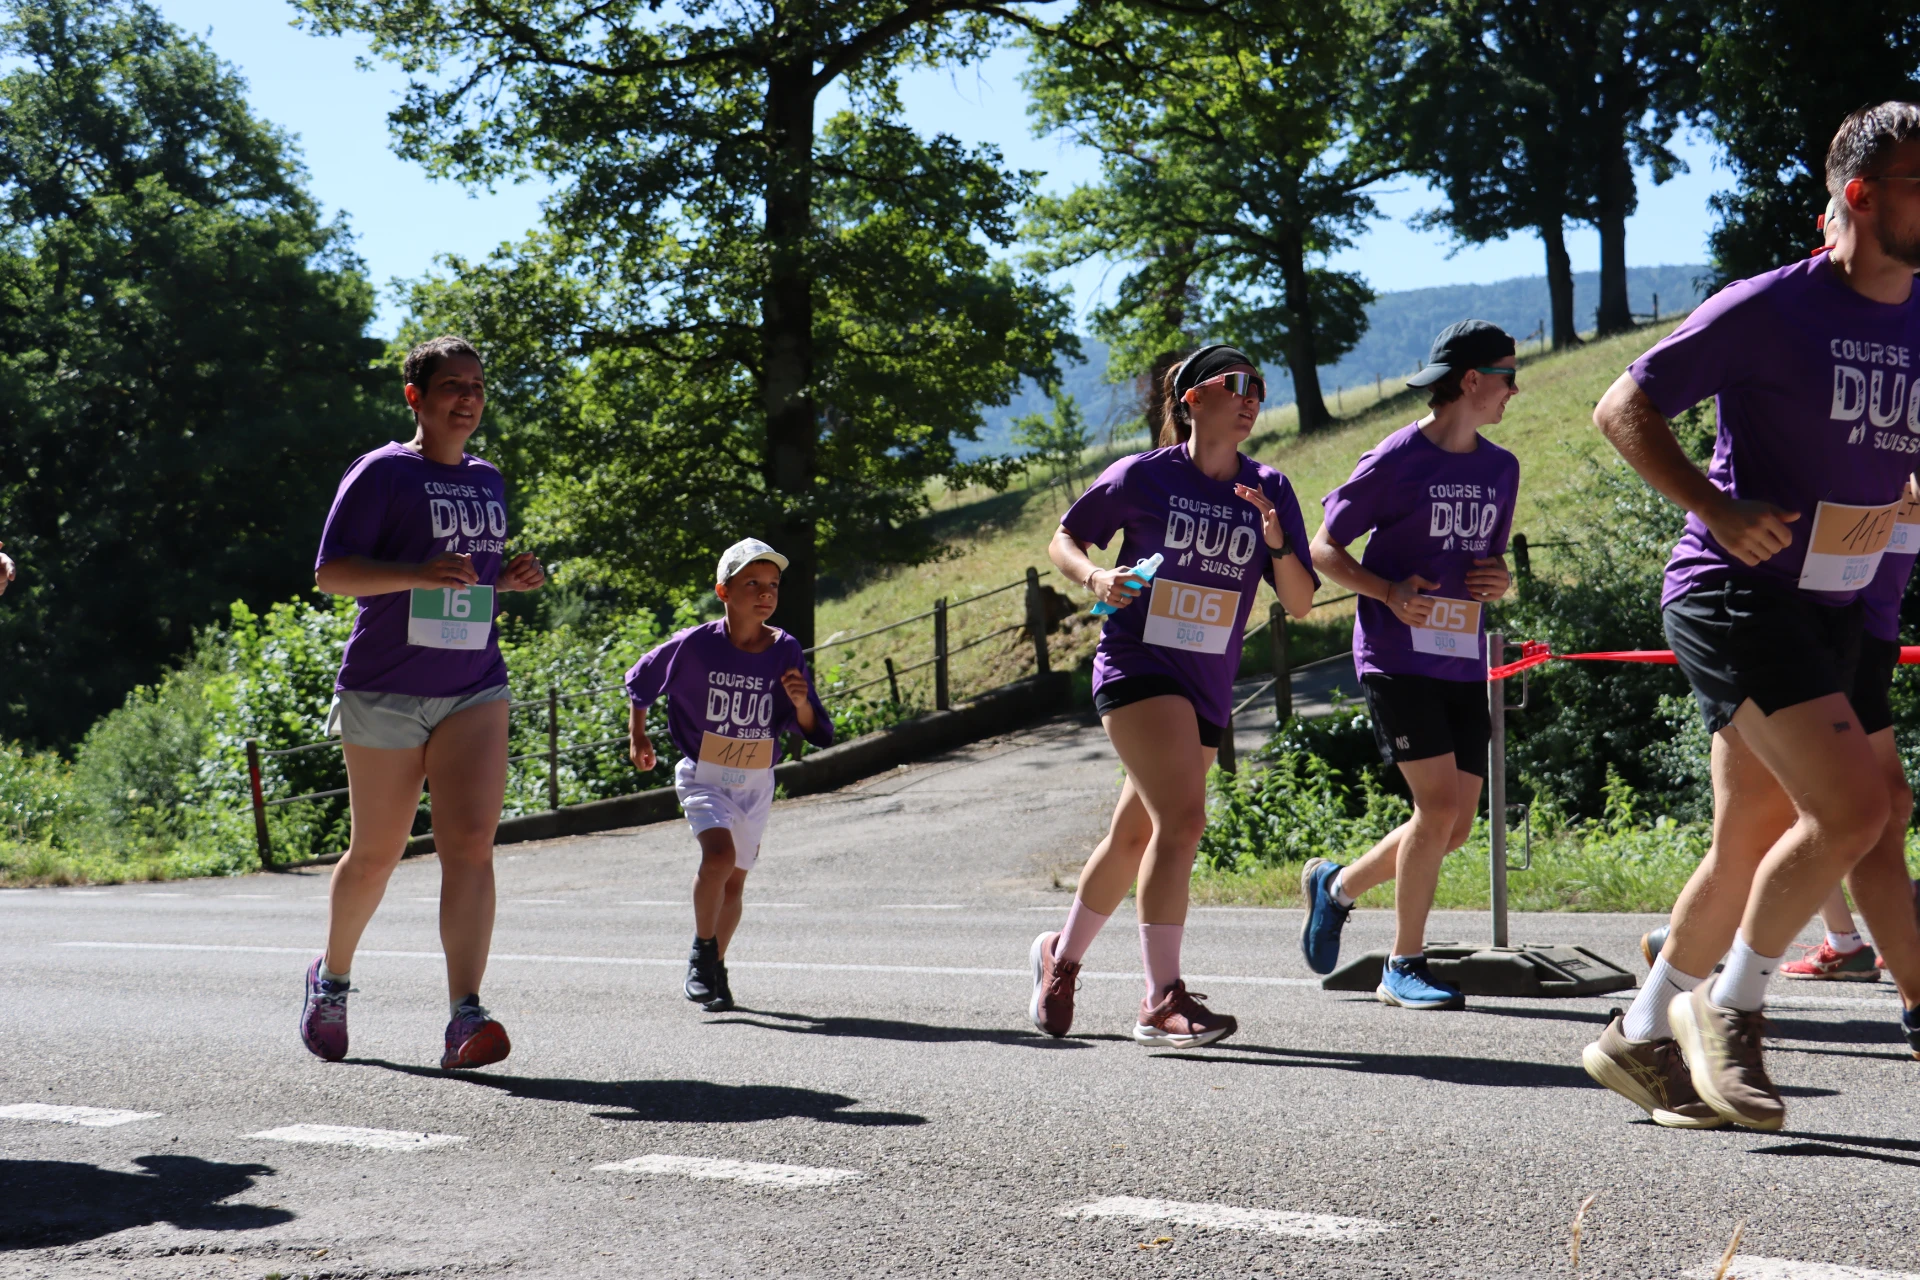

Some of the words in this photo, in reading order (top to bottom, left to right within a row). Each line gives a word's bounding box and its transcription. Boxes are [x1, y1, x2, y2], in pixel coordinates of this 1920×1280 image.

[1830, 338, 1910, 368] COURSE
[424, 482, 478, 498] COURSE
[1429, 484, 1481, 498] COURSE
[429, 499, 507, 538] DUO
[1169, 495, 1233, 519] COURSE
[1429, 501, 1497, 538] DUO
[1163, 510, 1257, 565] DUO
[1842, 510, 1892, 553] 117
[467, 540, 504, 554] SUISSE
[1200, 559, 1246, 580] SUISSE
[442, 587, 472, 618] 16
[1168, 586, 1223, 623] 106
[441, 627, 468, 640] DUO
[1176, 627, 1205, 643] DUO
[708, 671, 764, 690] COURSE
[706, 687, 773, 727] DUO
[737, 727, 772, 739] SUISSE
[717, 741, 759, 767] 117
